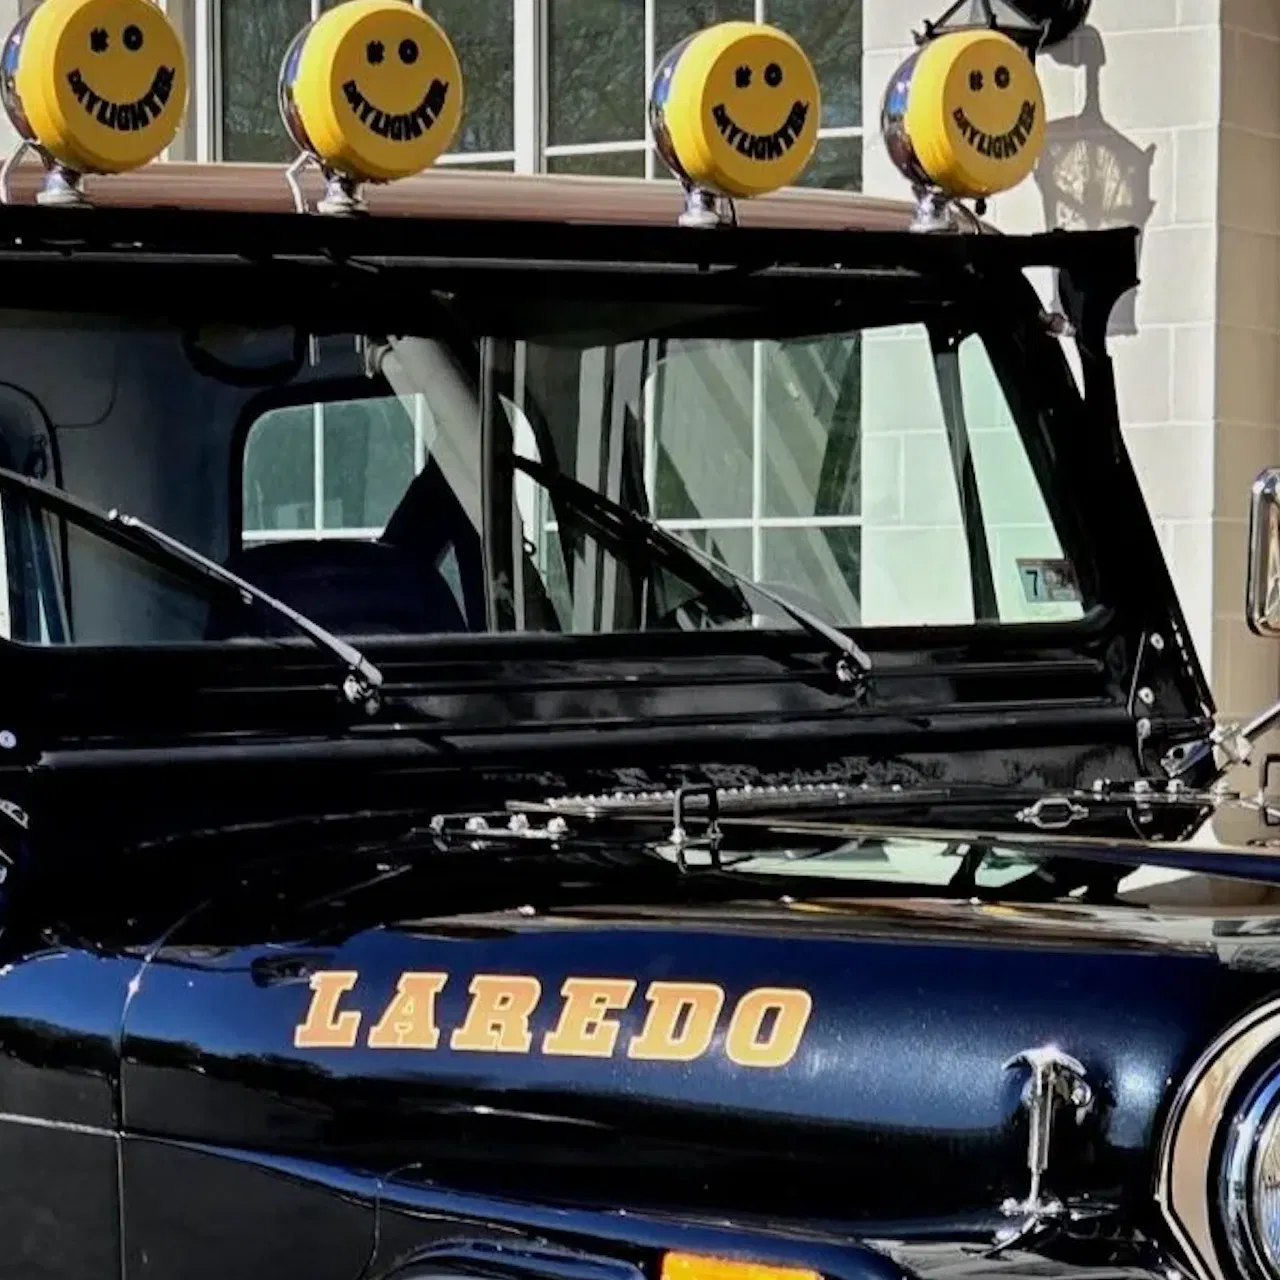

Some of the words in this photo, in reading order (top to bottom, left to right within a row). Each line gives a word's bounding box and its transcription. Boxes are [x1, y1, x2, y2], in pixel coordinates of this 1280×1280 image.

[712, 100, 810, 160] DAYLIGHTER
[953, 100, 1036, 160] DAYLIGHTER
[293, 969, 813, 1067] LAREDO
